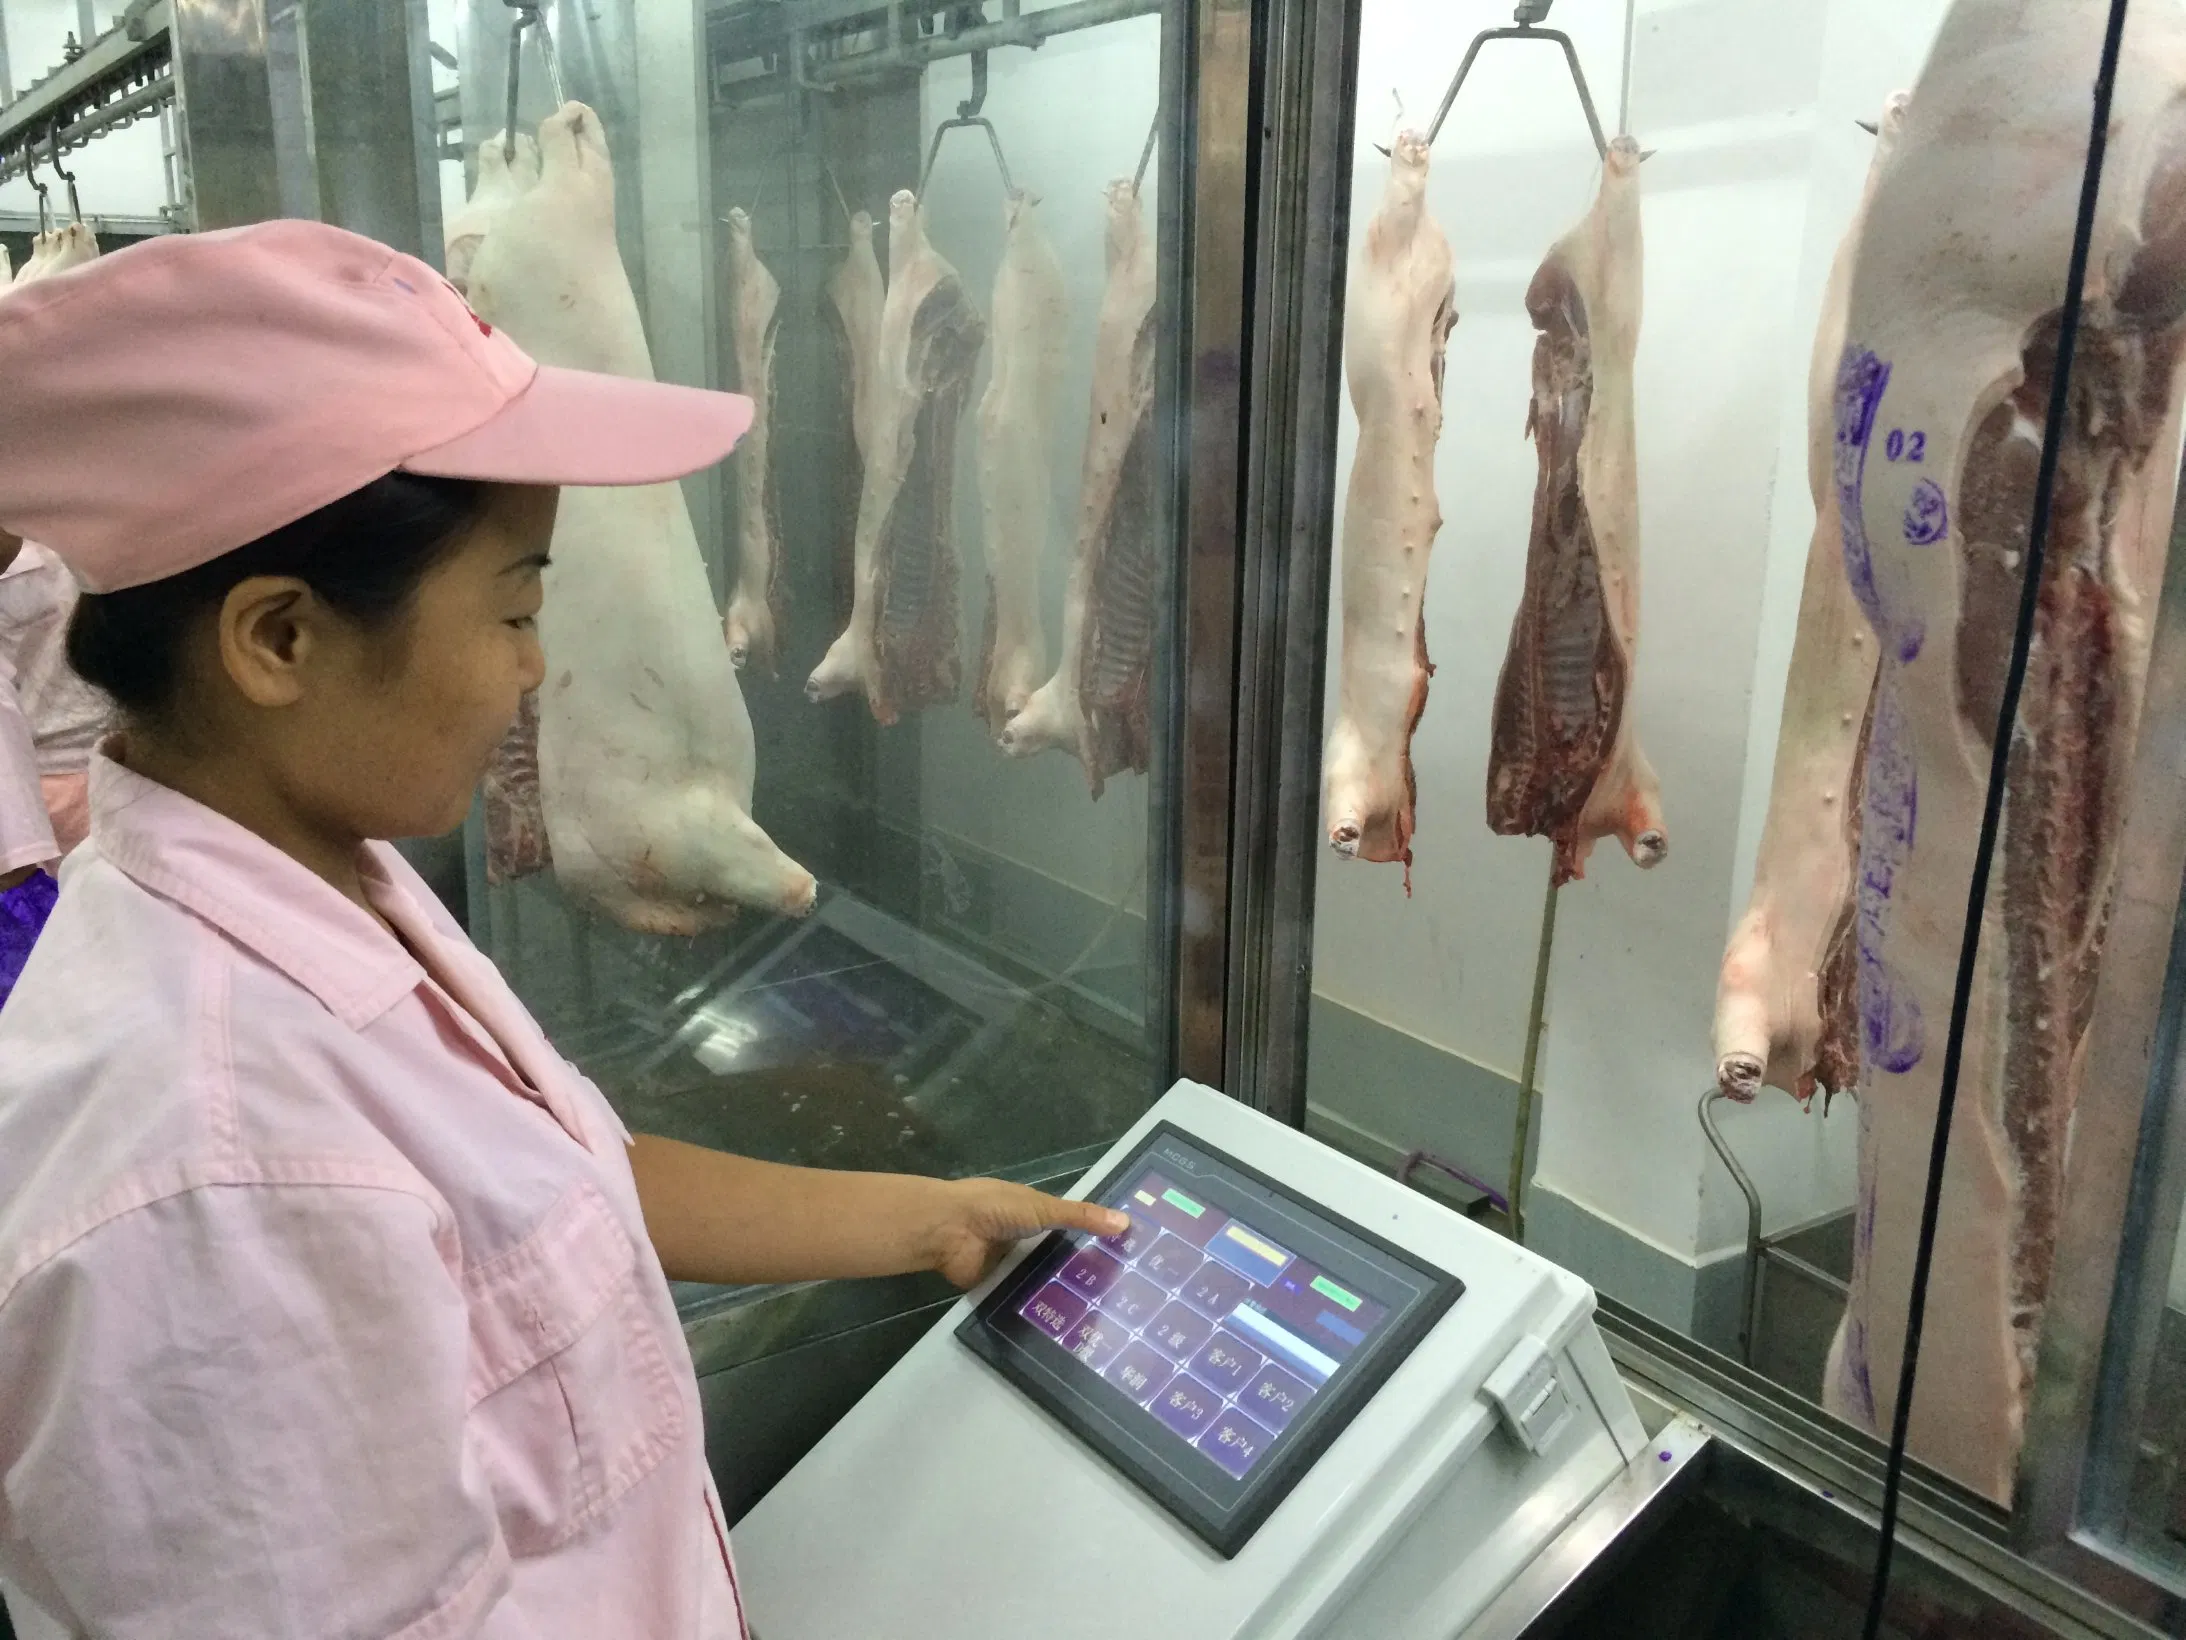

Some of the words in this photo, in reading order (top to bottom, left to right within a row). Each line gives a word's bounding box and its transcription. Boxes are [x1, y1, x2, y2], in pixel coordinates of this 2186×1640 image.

[1885, 428, 1926, 462] 02
[1163, 1148, 1196, 1170] MCGS
[1032, 1301, 1066, 1331] 双特选
[1208, 1347, 1242, 1376] 客户1
[1169, 1391, 1204, 1420] 客户3
[1258, 1382, 1294, 1412] 客户2
[1218, 1426, 1254, 1457] 客户4
